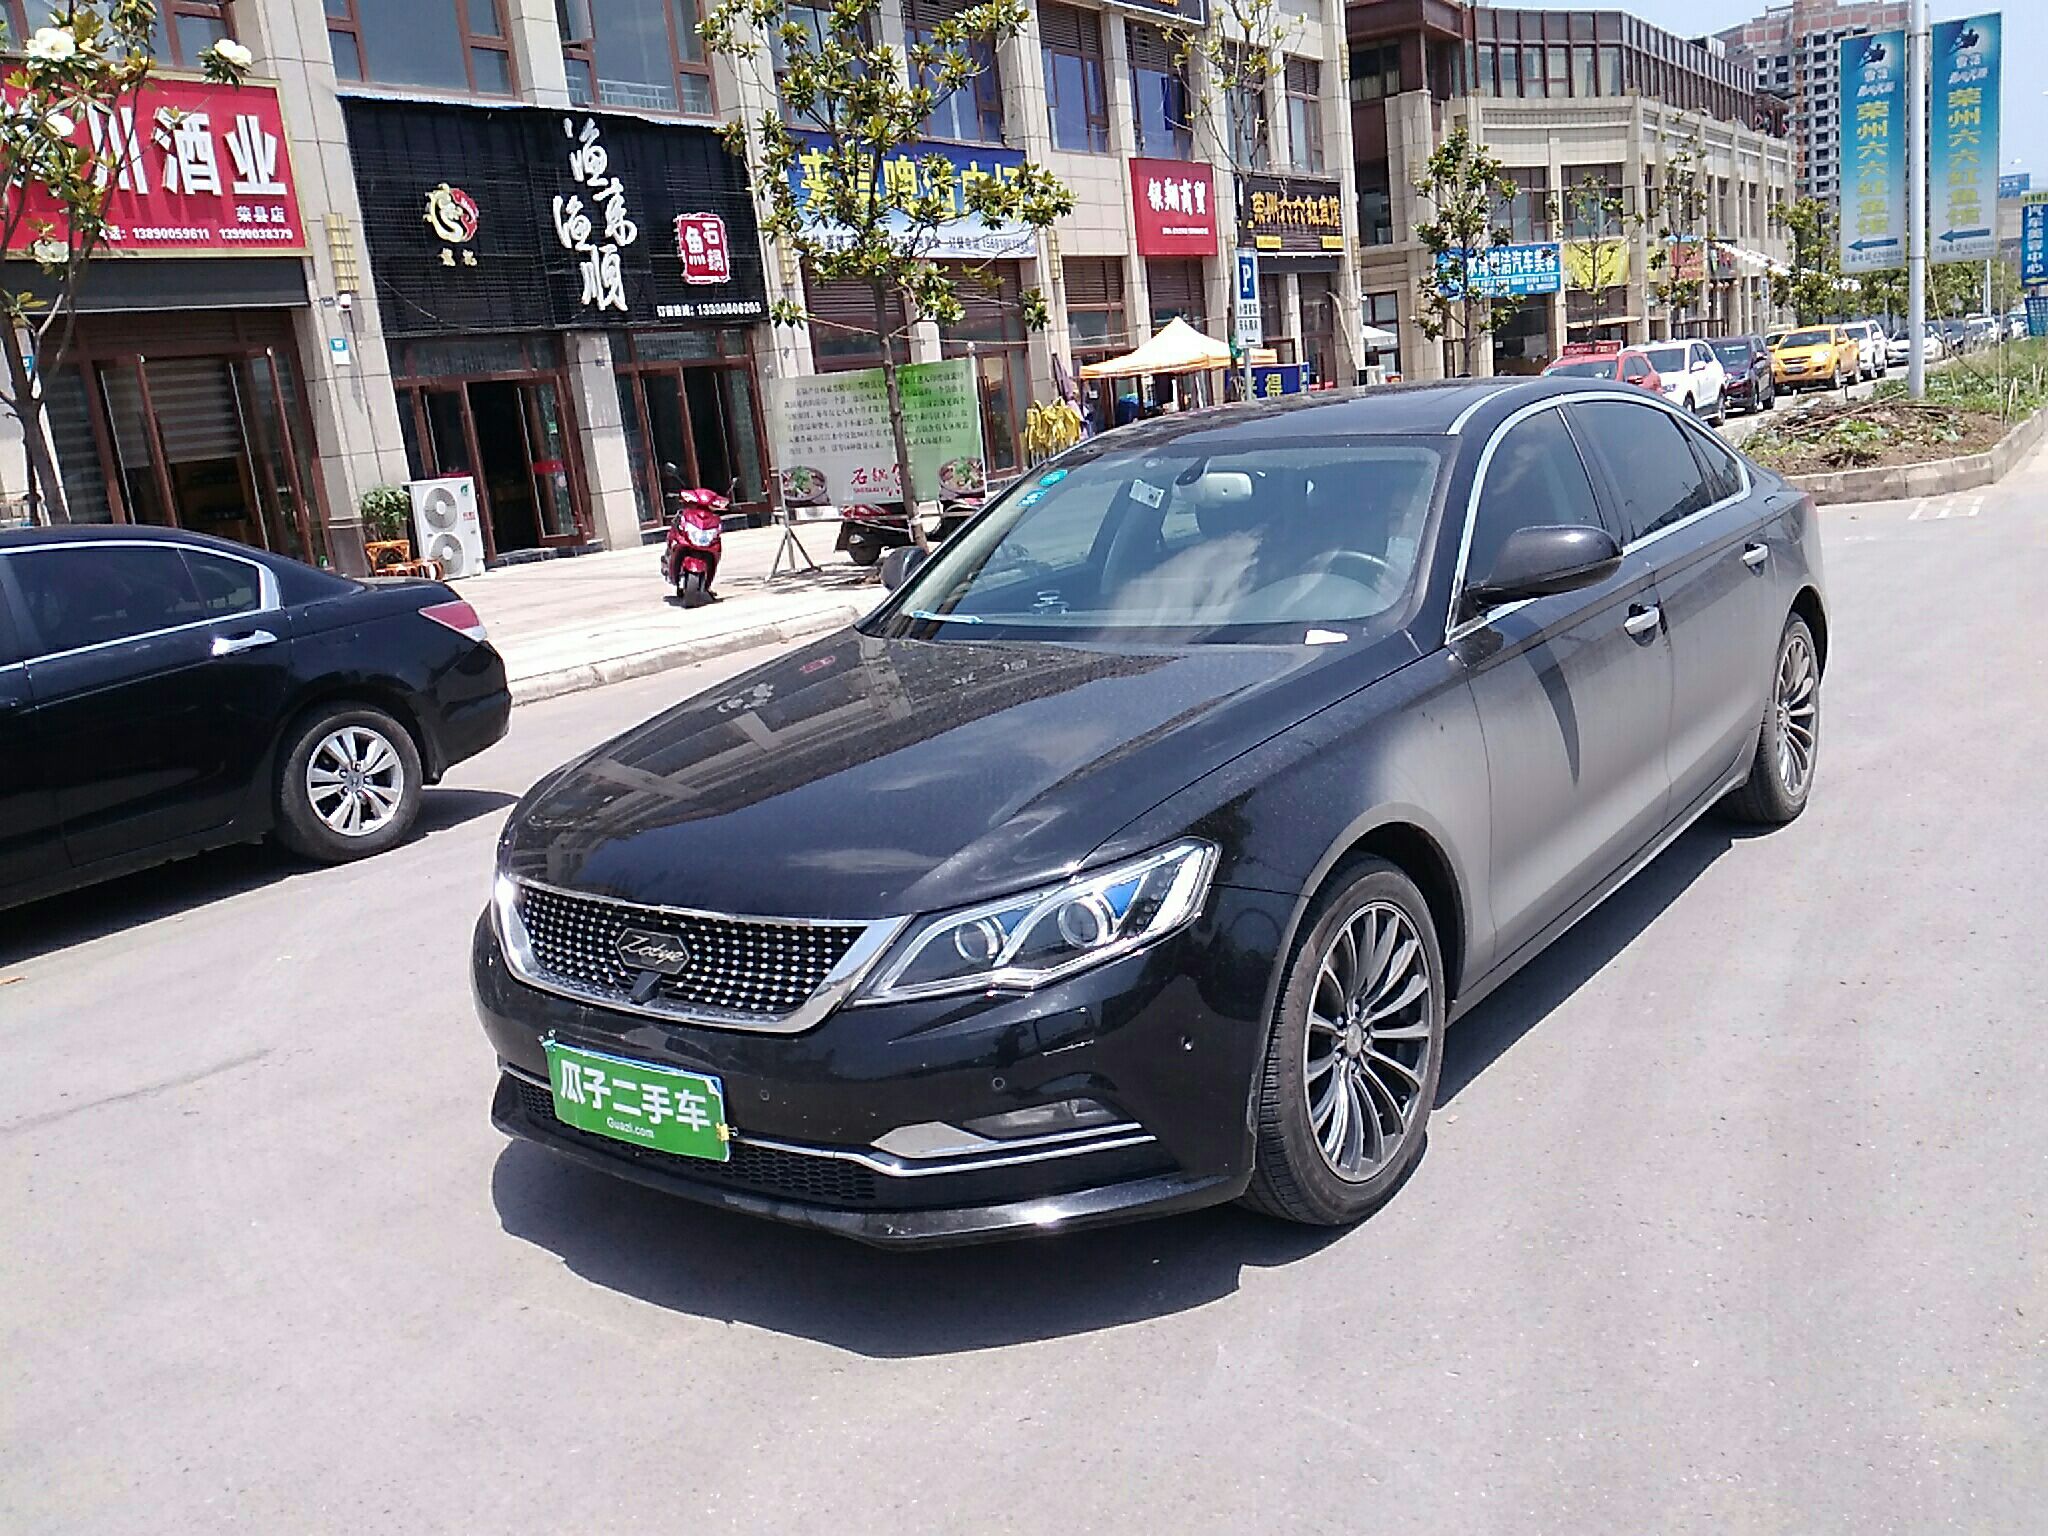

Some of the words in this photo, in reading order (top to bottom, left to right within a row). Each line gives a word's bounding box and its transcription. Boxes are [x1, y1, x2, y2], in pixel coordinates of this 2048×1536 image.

[235, 205, 286, 223] 荣县店
[1241, 264, 1252, 292] P
[560, 1059, 711, 1132] 瓜子二手车
[607, 1116, 655, 1139] Guazi.com
